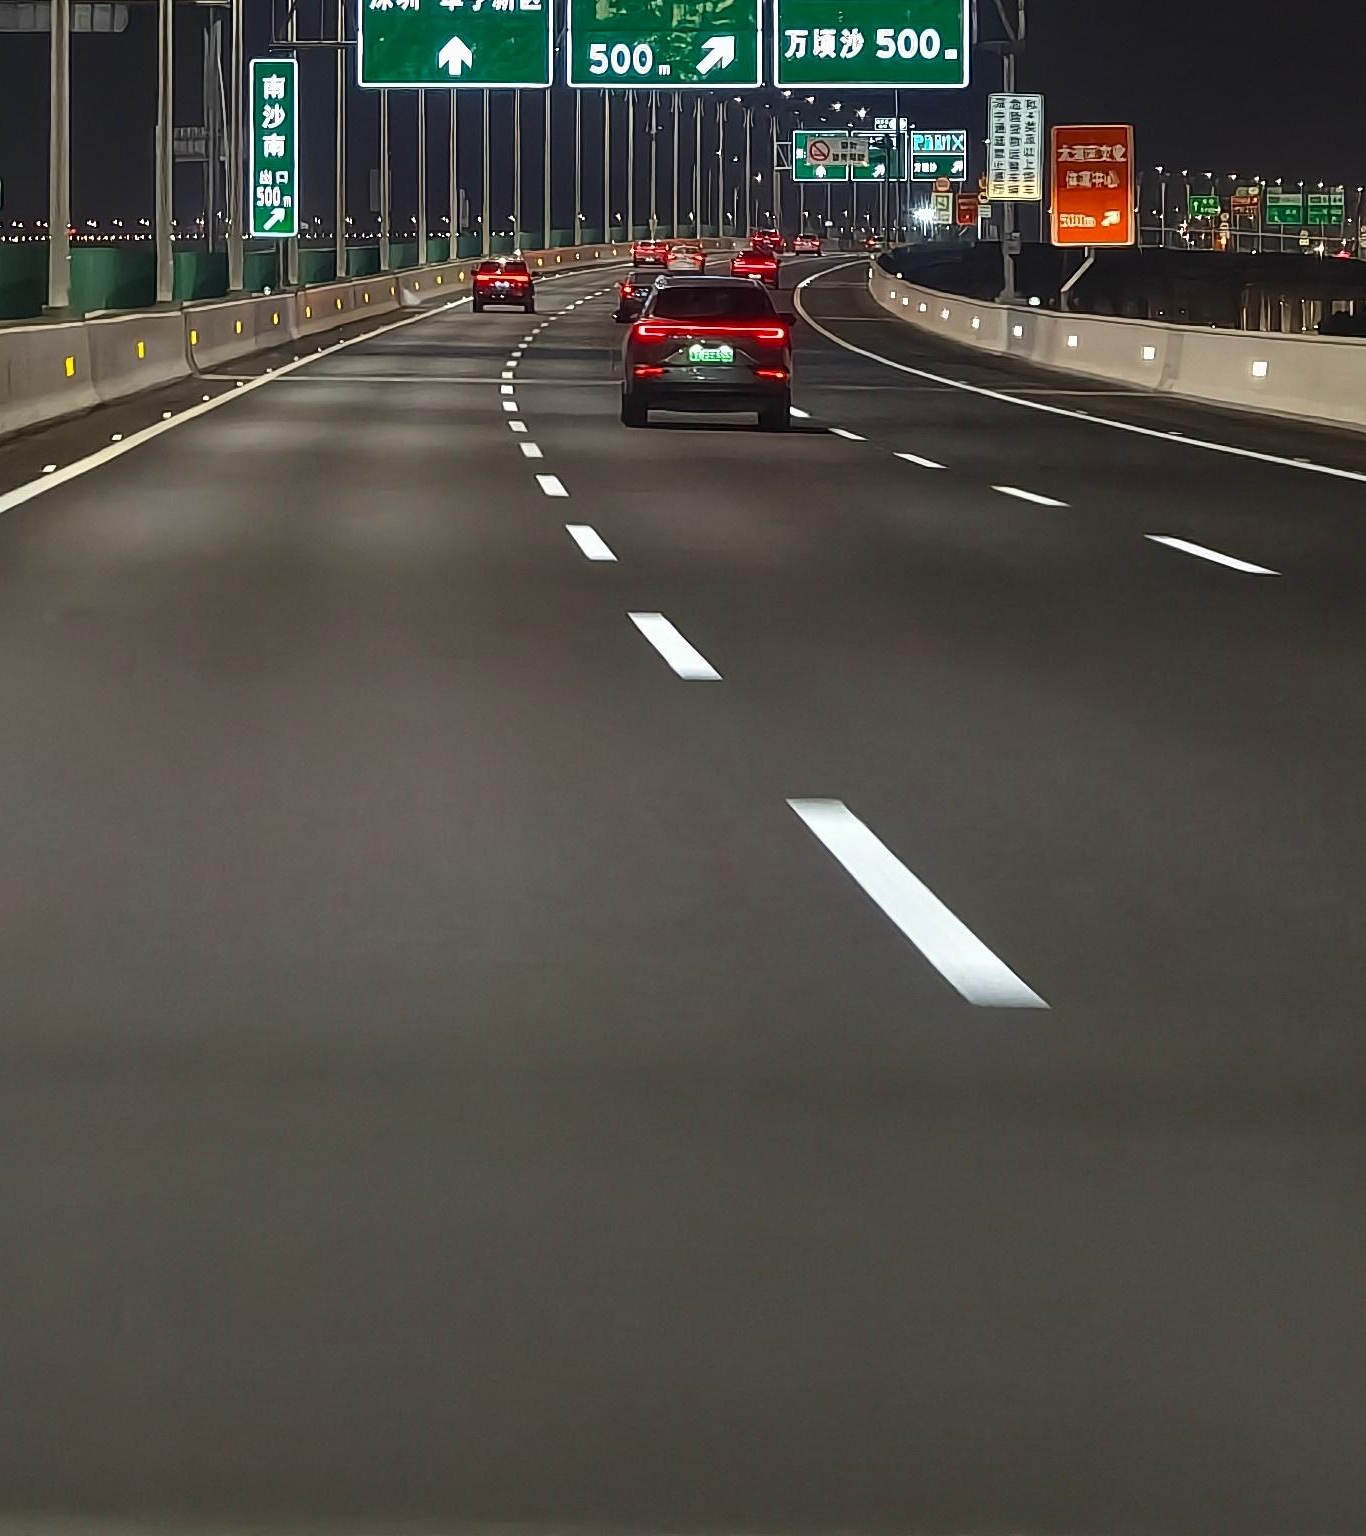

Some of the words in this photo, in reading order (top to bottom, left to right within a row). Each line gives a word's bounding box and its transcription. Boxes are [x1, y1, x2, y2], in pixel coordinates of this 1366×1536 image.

[784, 27, 865, 59] 万顷沙
[262, 73, 286, 158] 南沙南
[259, 168, 289, 185] 出口
